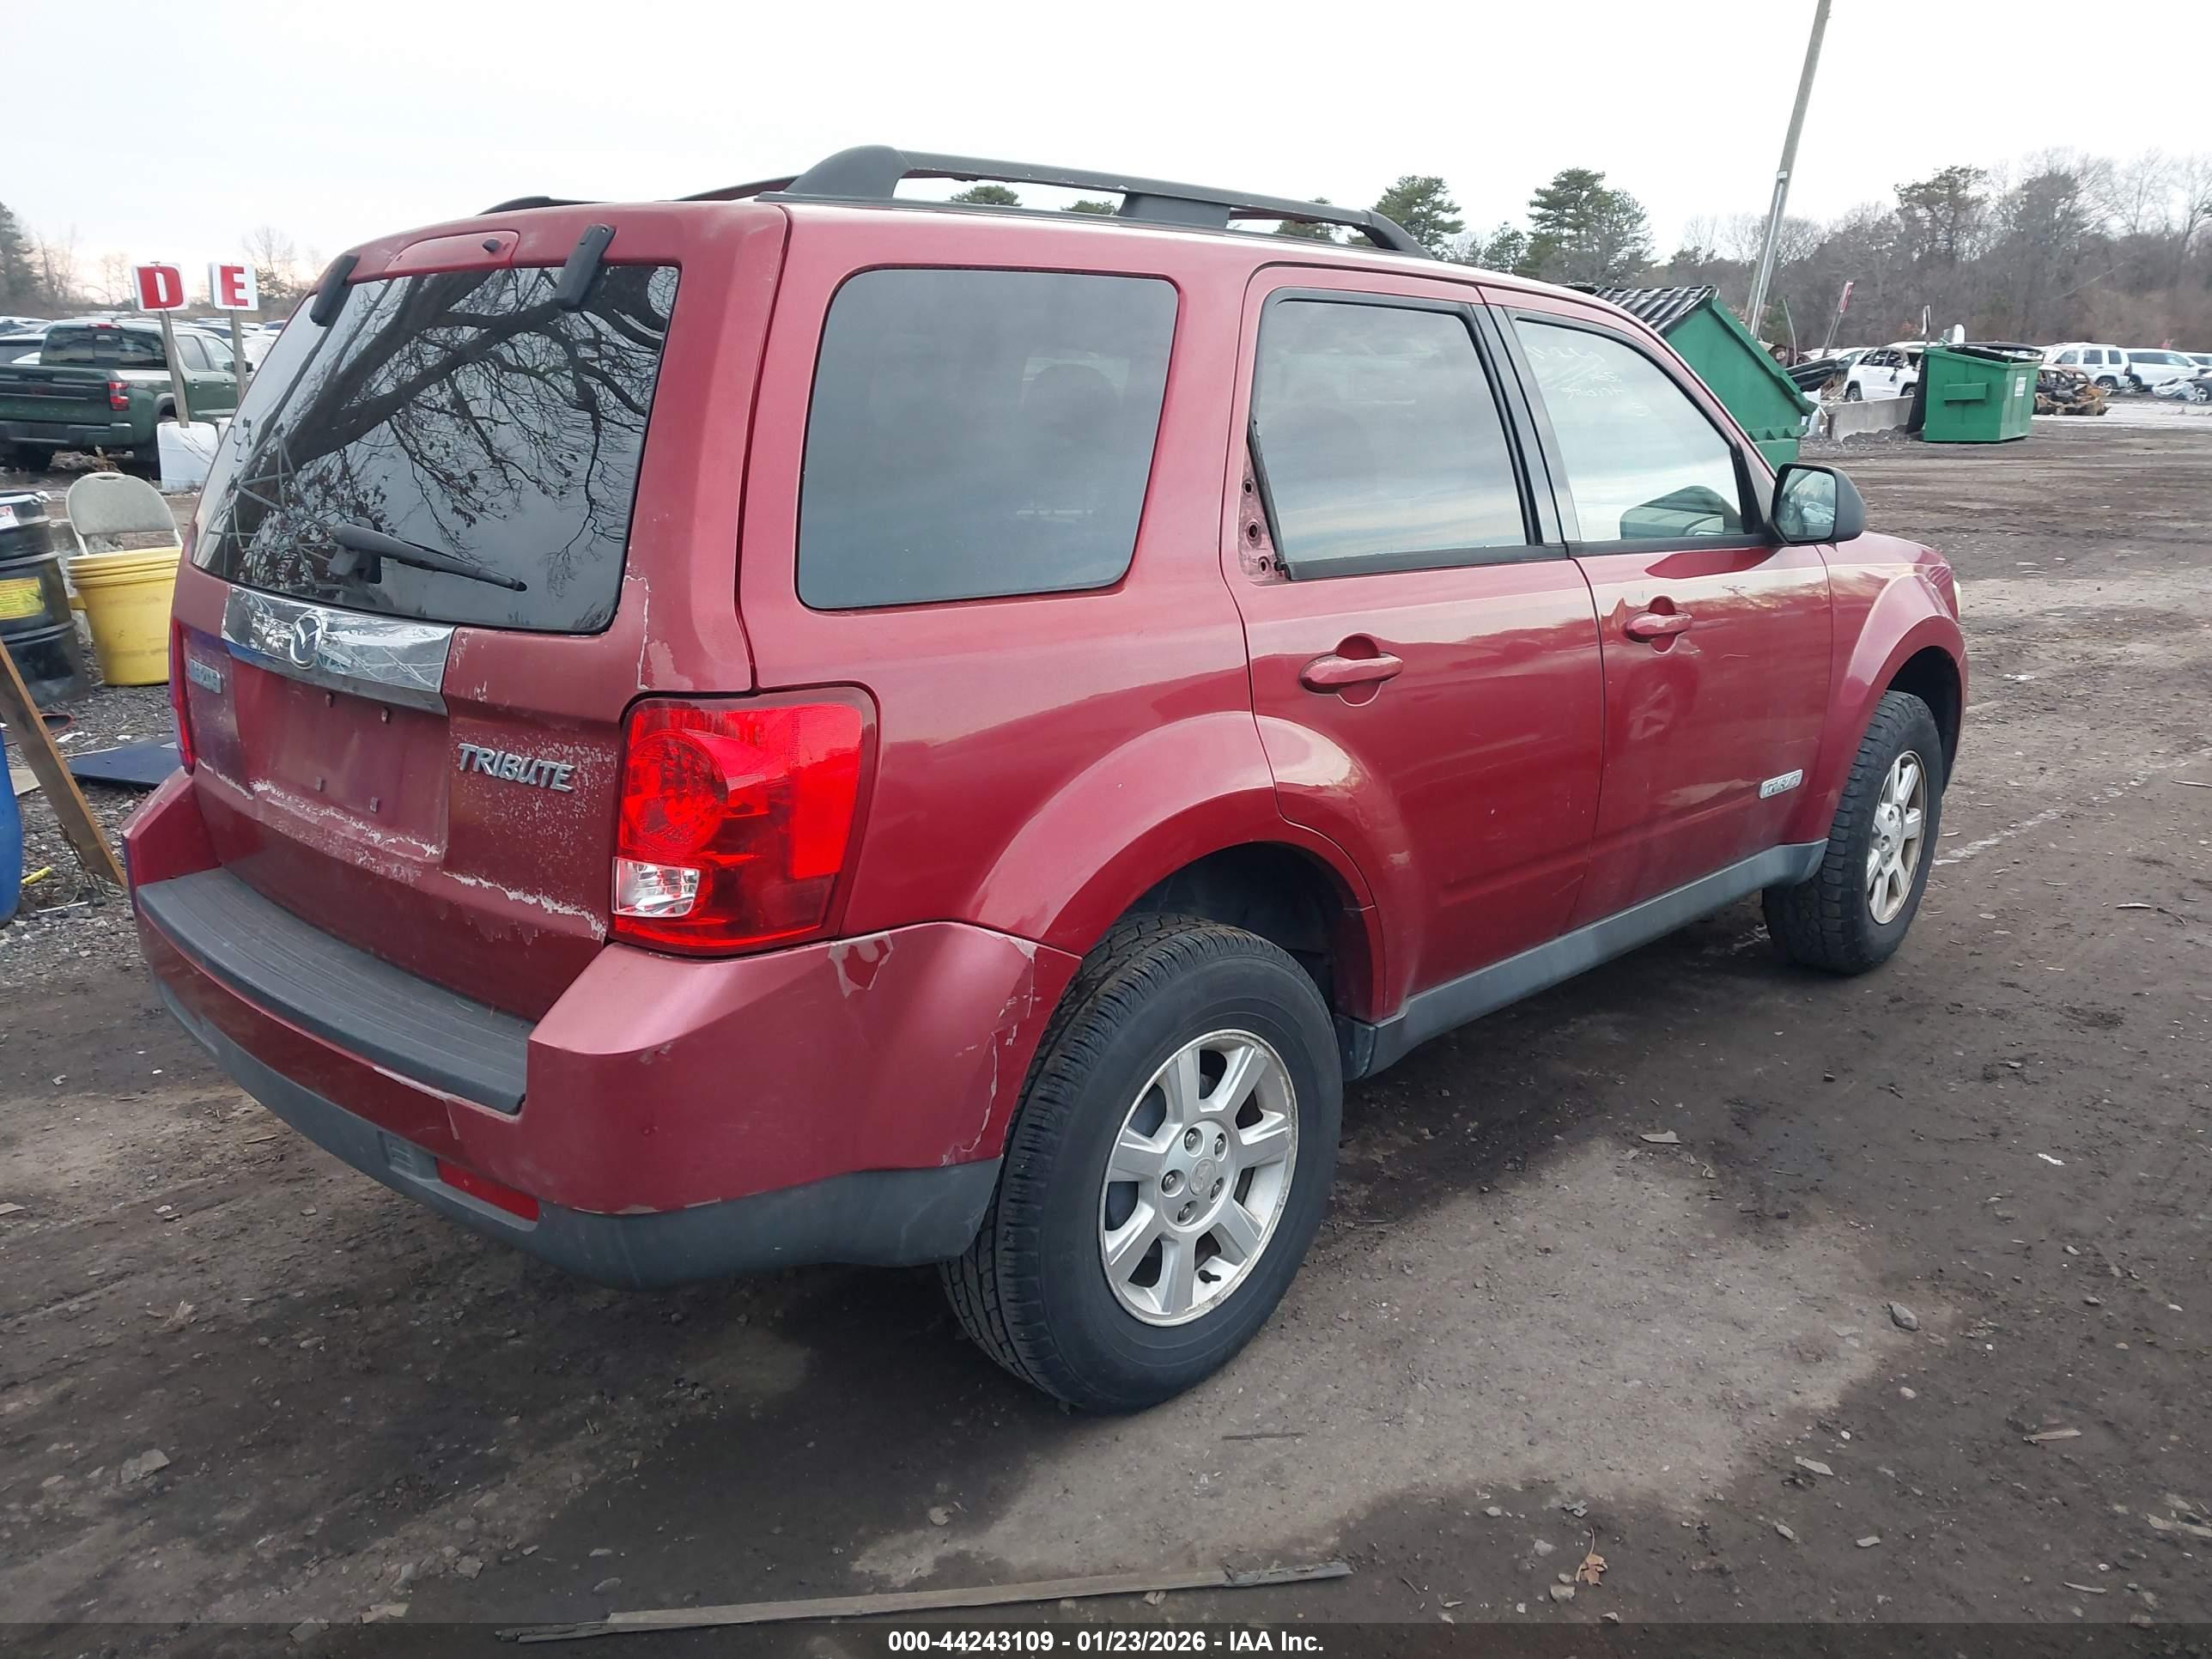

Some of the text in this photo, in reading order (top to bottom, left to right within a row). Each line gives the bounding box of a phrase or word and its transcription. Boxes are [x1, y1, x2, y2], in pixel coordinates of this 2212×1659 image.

[137, 265, 184, 309] D
[220, 264, 248, 307] E
[458, 743, 576, 793] TRIBUTE
